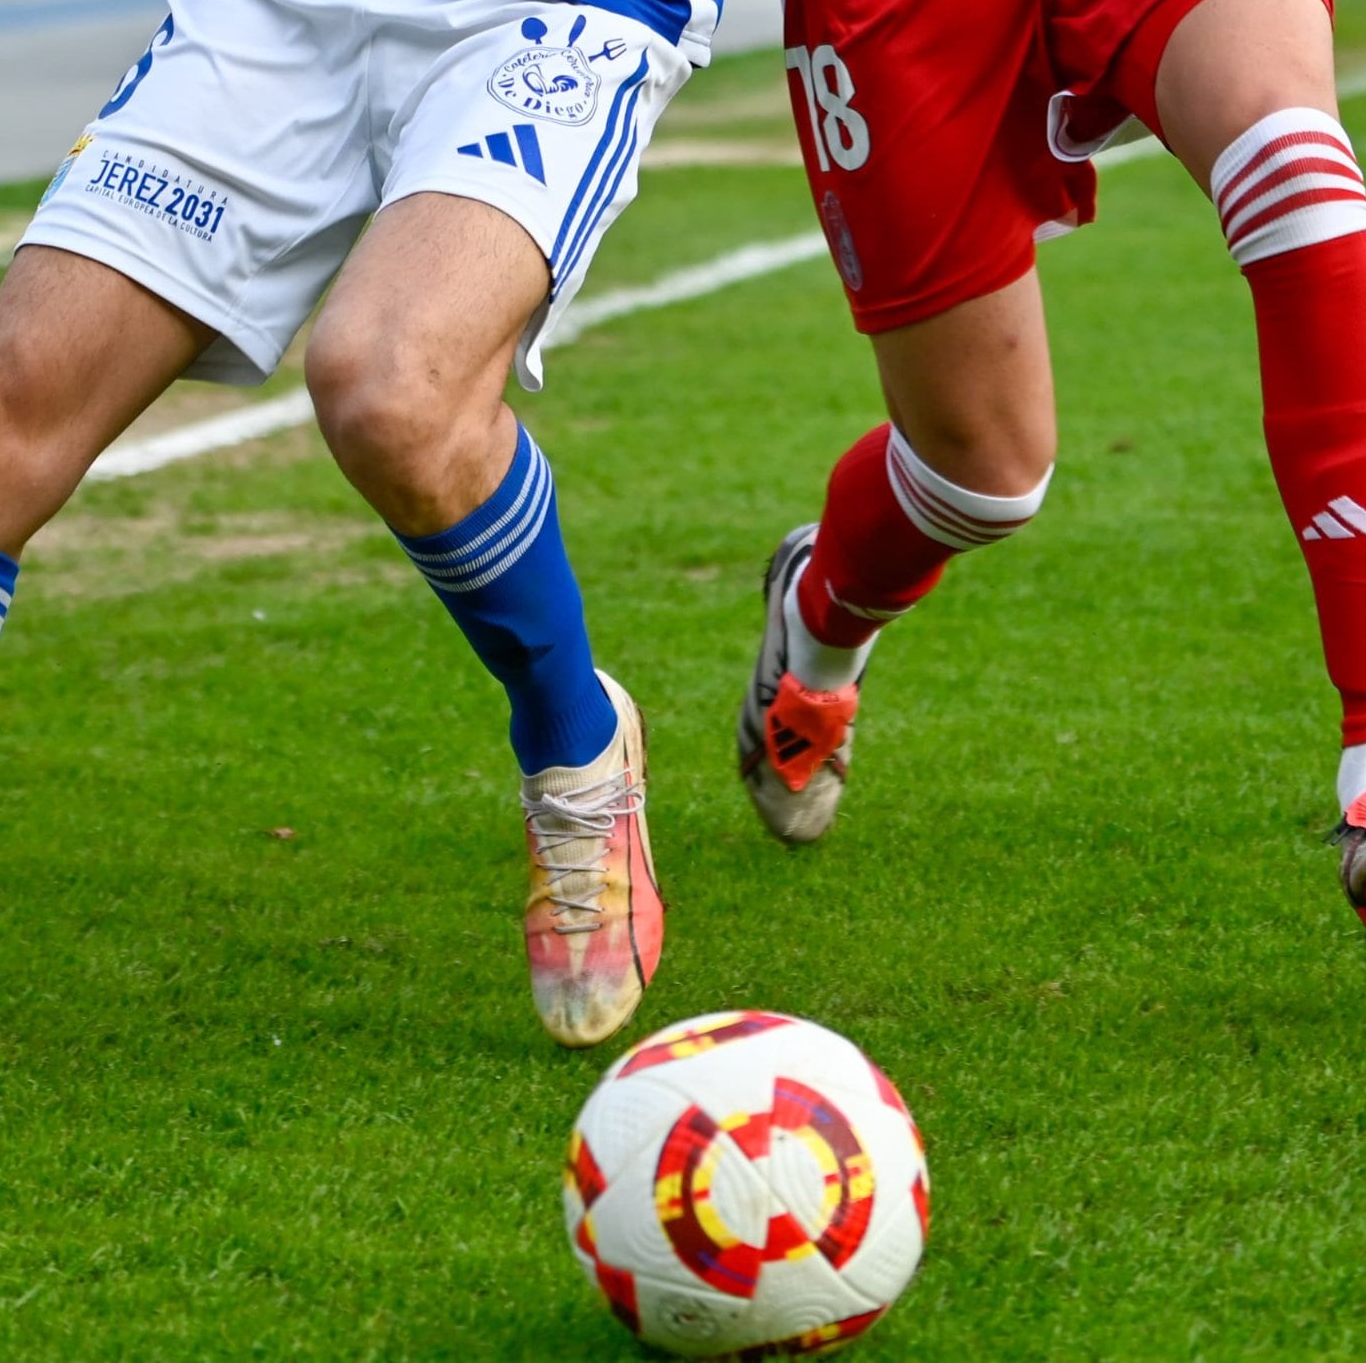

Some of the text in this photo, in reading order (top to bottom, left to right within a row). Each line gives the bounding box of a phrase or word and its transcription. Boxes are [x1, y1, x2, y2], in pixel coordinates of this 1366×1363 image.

[522, 96, 585, 119] Diego
[89, 158, 226, 235] JEREZ 2031
[102, 149, 229, 206] CANDIDATURA
[84, 184, 115, 200] CAPITAL
[117, 195, 155, 217] EUROPEA
[179, 222, 214, 244] CULTURA
